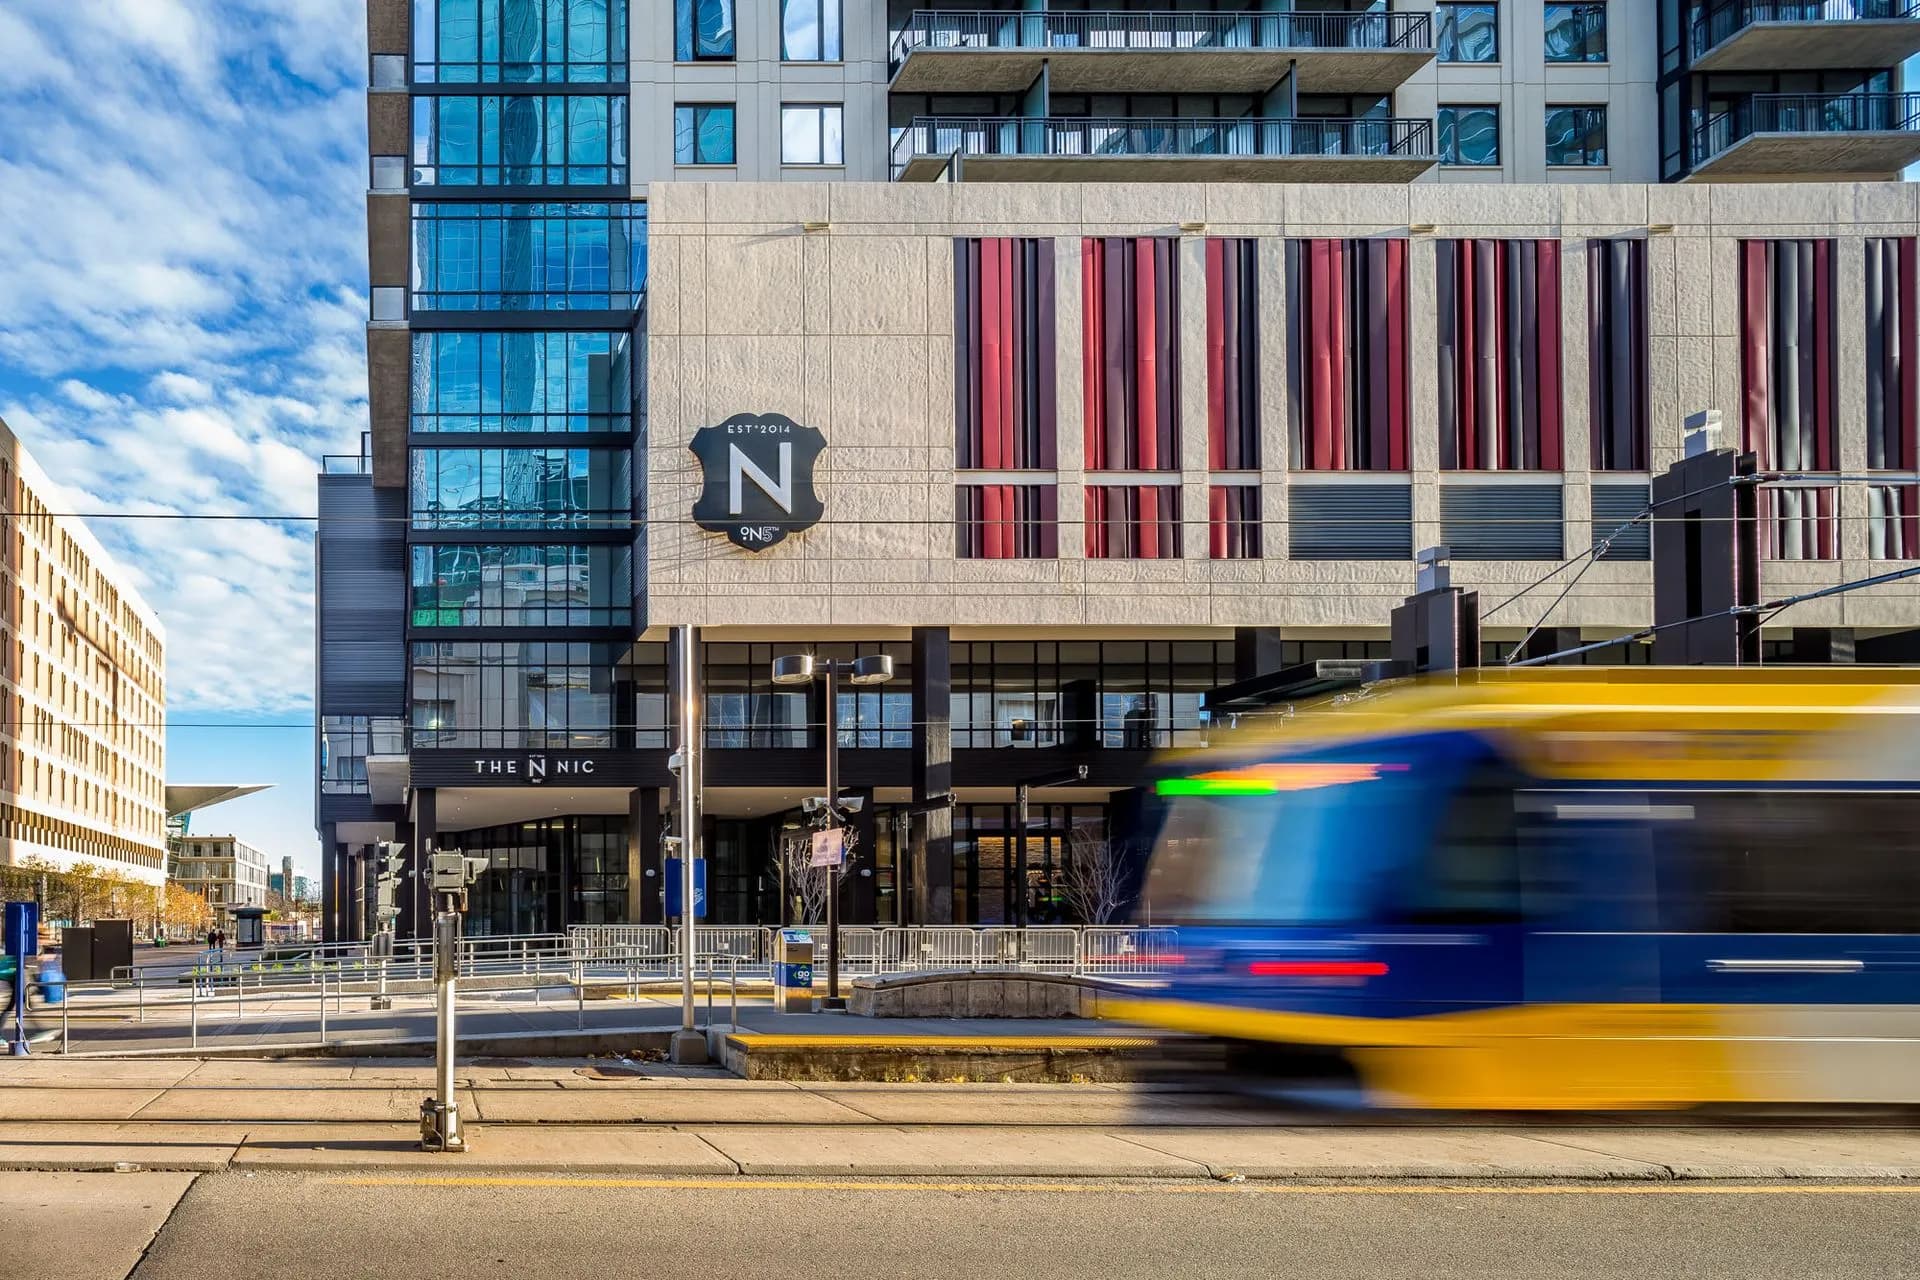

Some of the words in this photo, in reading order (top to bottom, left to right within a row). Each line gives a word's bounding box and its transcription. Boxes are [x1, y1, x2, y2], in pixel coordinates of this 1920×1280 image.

[729, 442, 792, 514] N
[475, 760, 516, 773] THE
[529, 758, 546, 777] N
[557, 760, 594, 773] NIC
